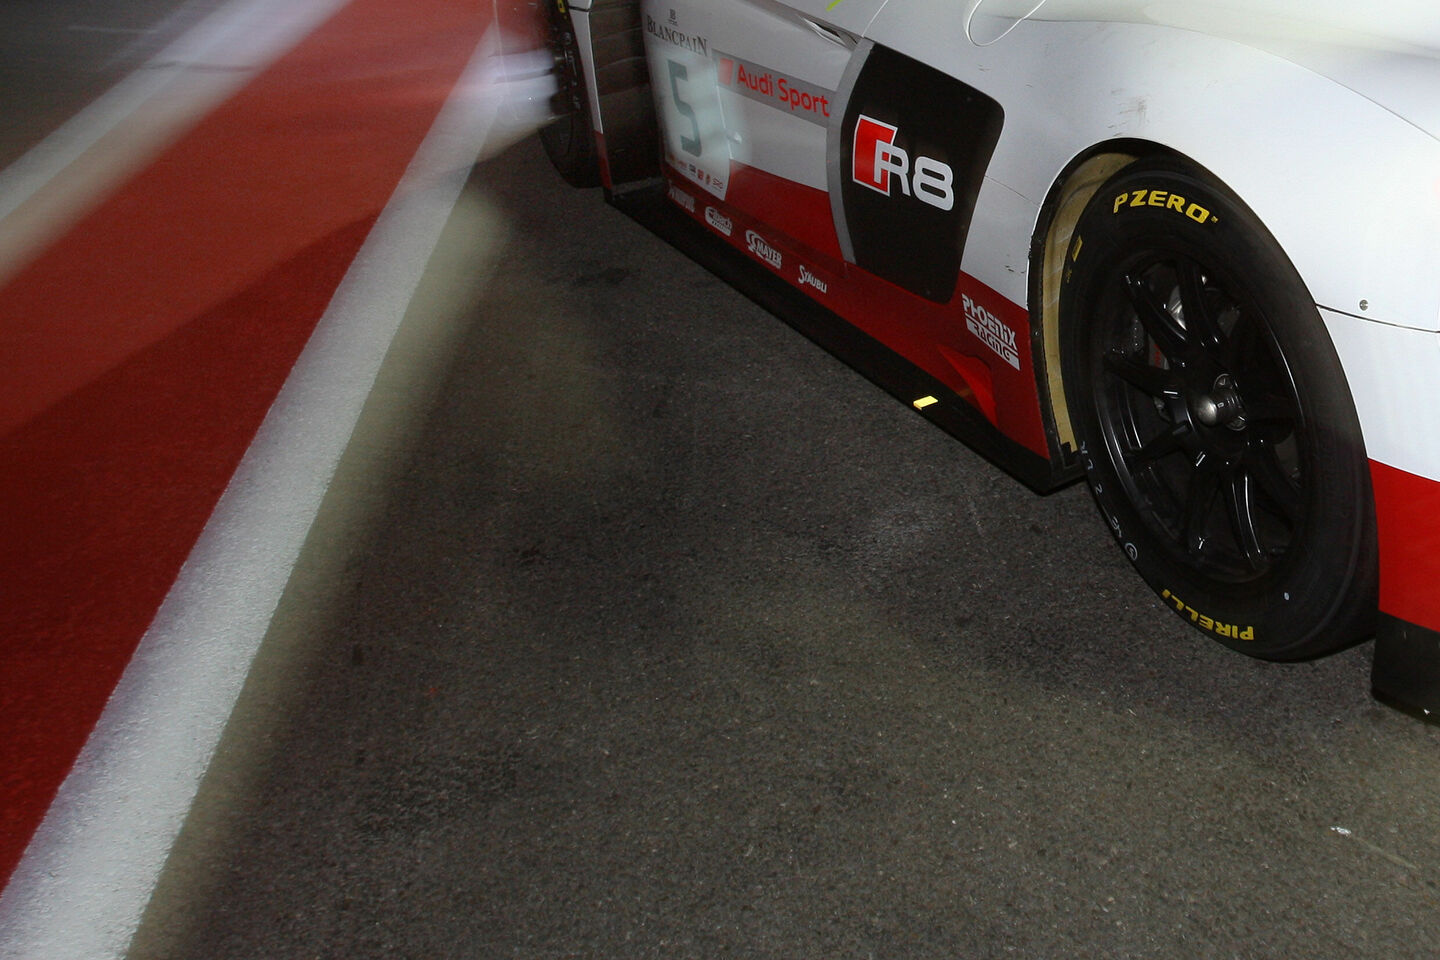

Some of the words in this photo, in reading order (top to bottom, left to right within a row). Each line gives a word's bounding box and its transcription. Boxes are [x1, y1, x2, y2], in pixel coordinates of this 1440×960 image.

[647, 14, 708, 56] BLANCPAIN
[667, 59, 703, 157] 5
[736, 64, 774, 97] Audi
[777, 78, 830, 117] Sport
[872, 137, 955, 212] R8
[1162, 589, 1254, 640] PIRELLI
